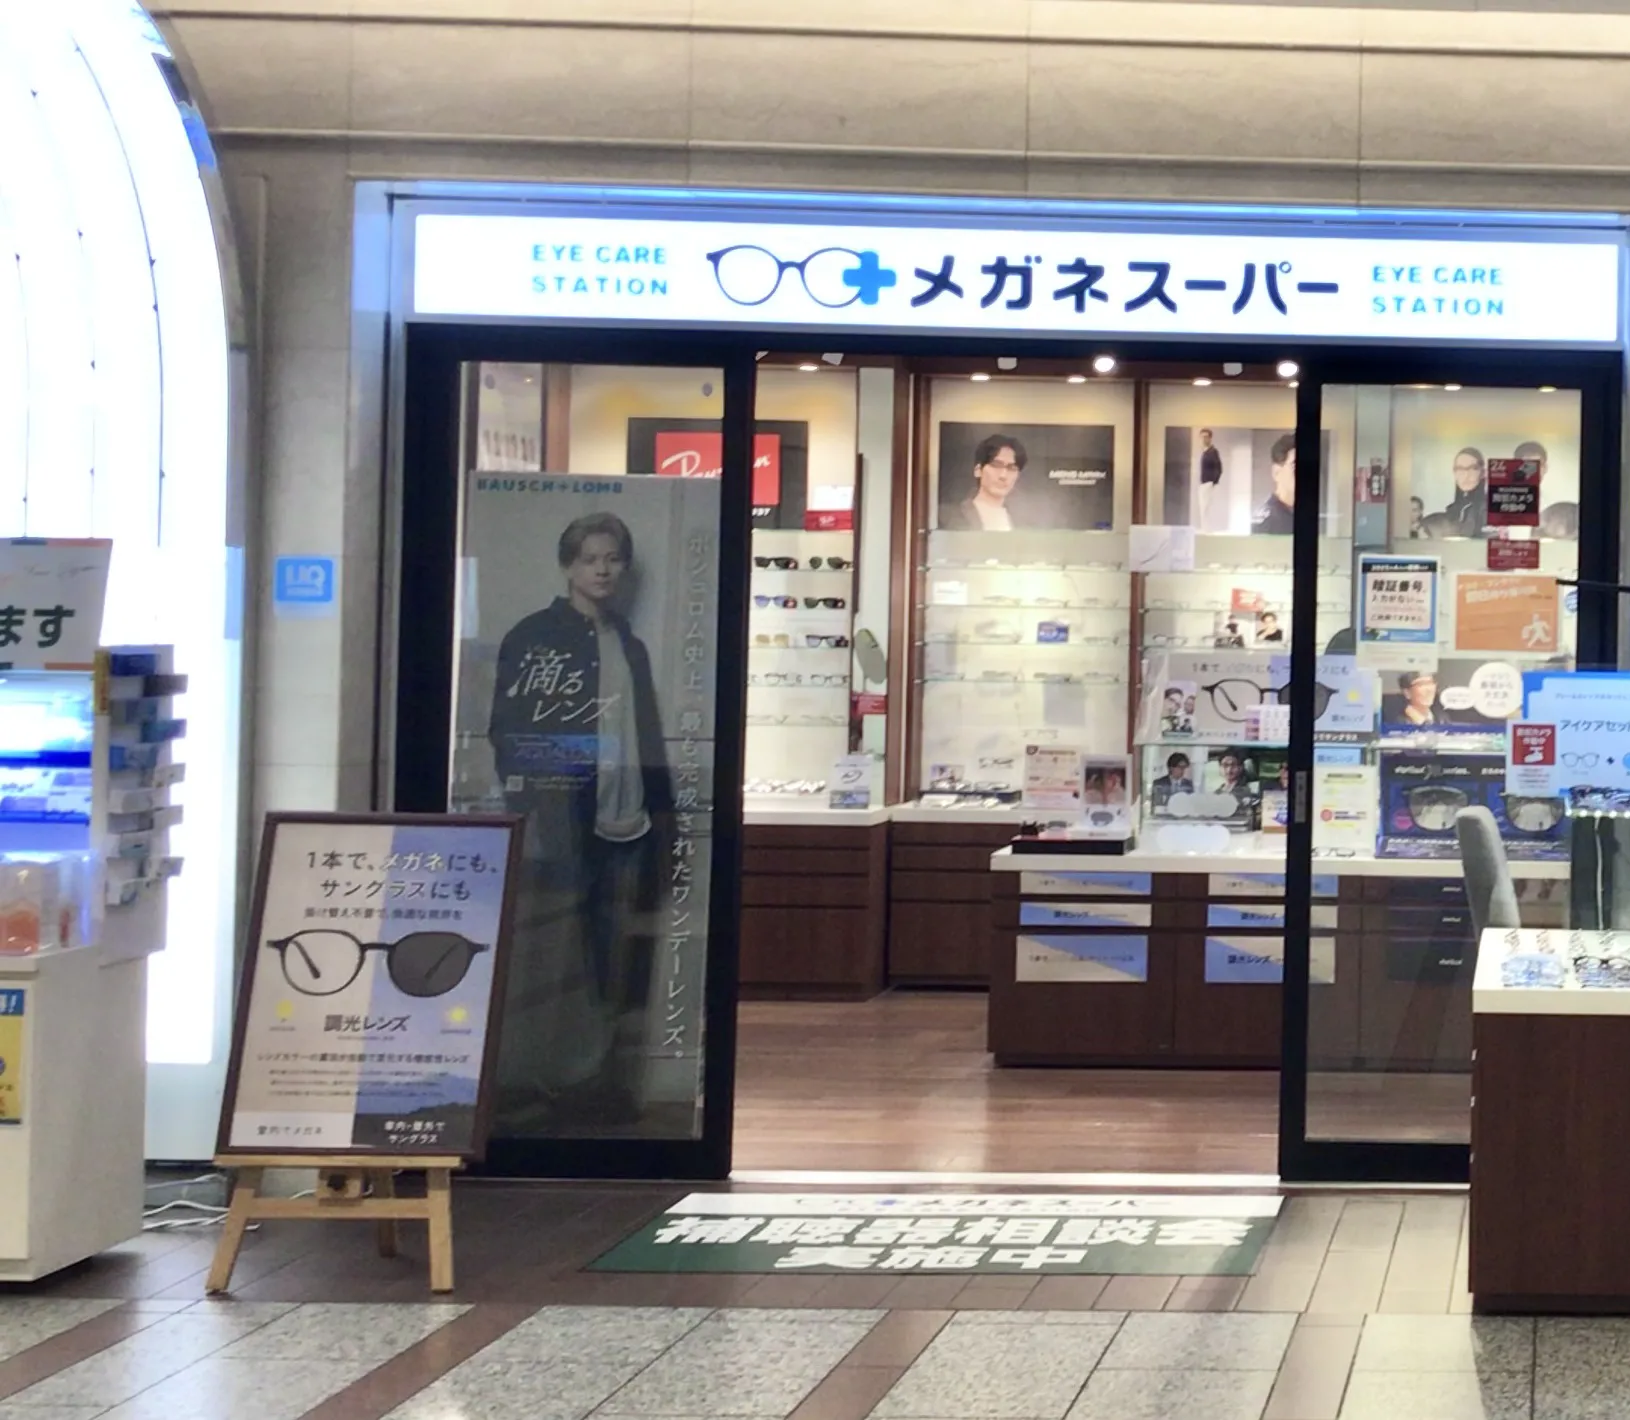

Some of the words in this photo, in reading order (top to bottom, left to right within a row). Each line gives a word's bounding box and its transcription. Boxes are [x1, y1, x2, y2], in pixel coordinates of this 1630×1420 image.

[532, 243, 584, 263] EYE
[595, 245, 668, 265] CARE
[532, 275, 668, 296] STATION
[910, 252, 1340, 317] メガネスーパー
[1372, 264, 1422, 284] EYE
[1433, 266, 1503, 286] CARE
[1372, 295, 1504, 317] STATION
[507, 650, 584, 698] 滴る
[532, 693, 621, 724] レンズ
[305, 850, 499, 875] 1本で、メガネにも、
[319, 878, 472, 902] サングラスにも
[322, 1014, 413, 1033] 調光レンズ
[387, 1133, 439, 1145] サングラス
[651, 1215, 1259, 1247] 補聴器相談会
[772, 1245, 1090, 1271] 実施中
